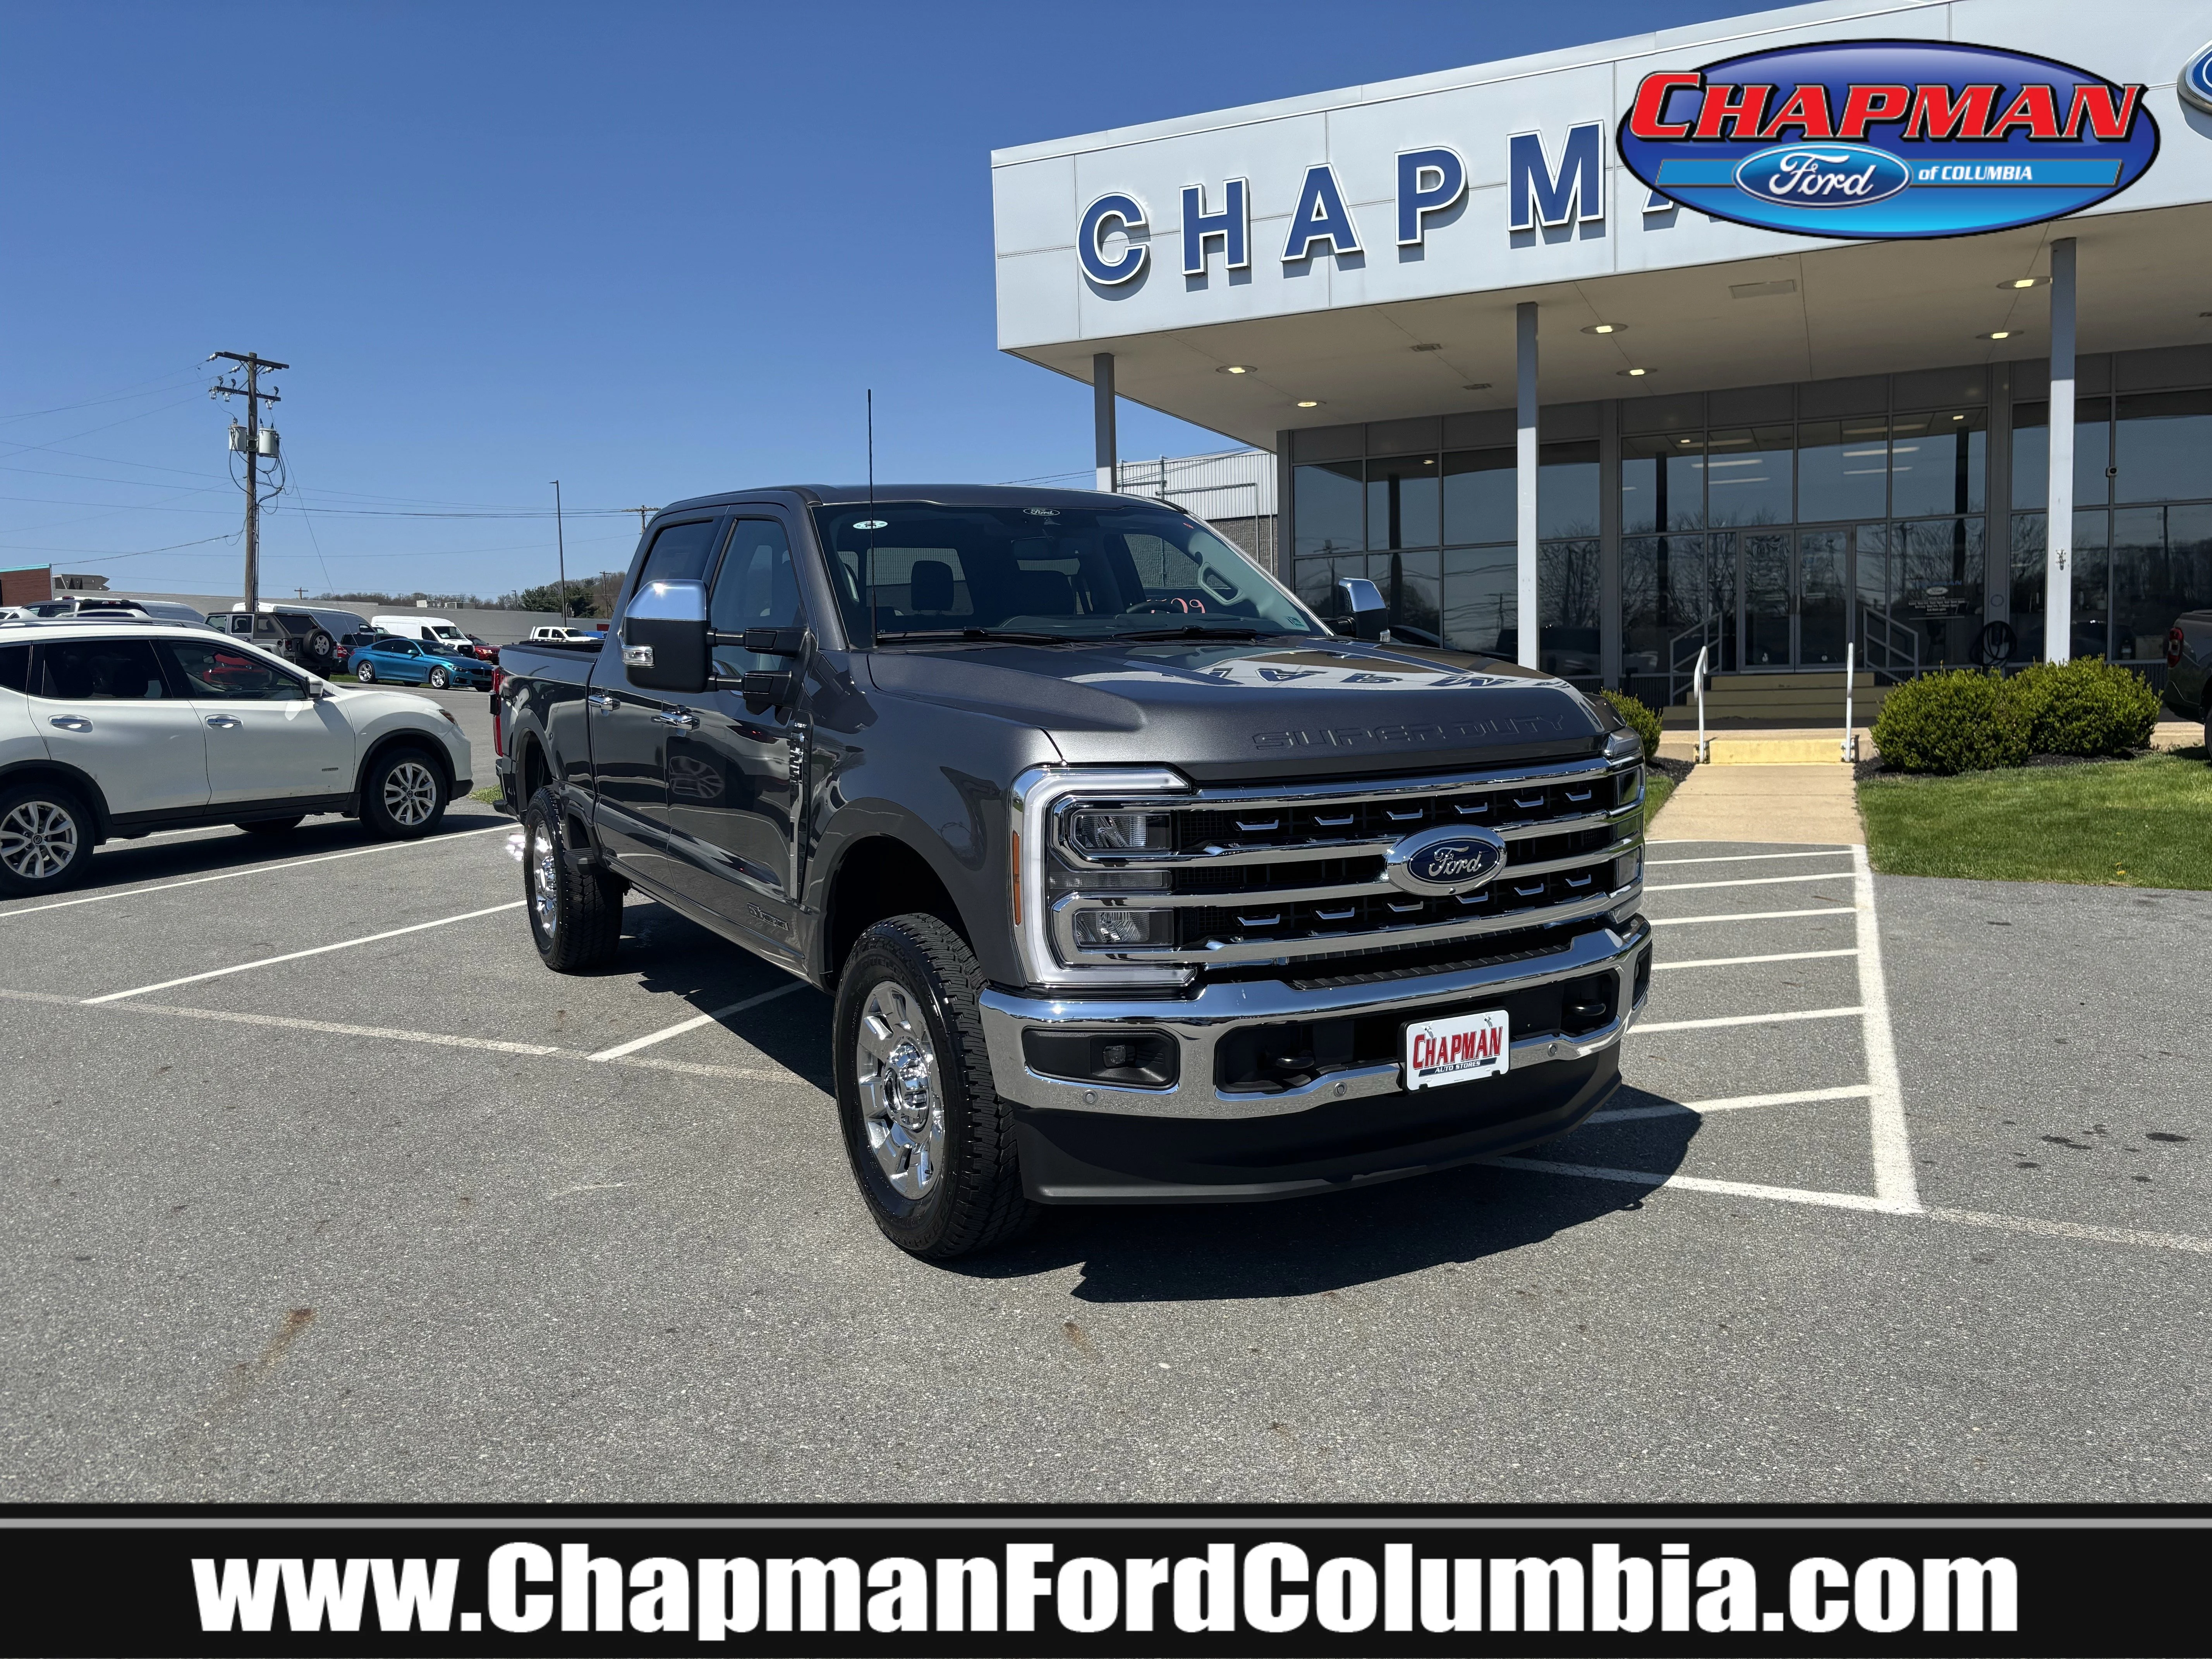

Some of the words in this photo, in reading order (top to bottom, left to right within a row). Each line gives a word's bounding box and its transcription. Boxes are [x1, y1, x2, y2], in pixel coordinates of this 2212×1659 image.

[1076, 119, 1677, 285] CHAPM
[1252, 724, 1446, 750] SUPER
[1453, 714, 1565, 738] DUTY
[1428, 845, 1482, 876] Ford
[1413, 1026, 1503, 1070] CHAPMAN
[1435, 1065, 1454, 1073] AUTO
[1455, 1060, 1481, 1070] STORES
